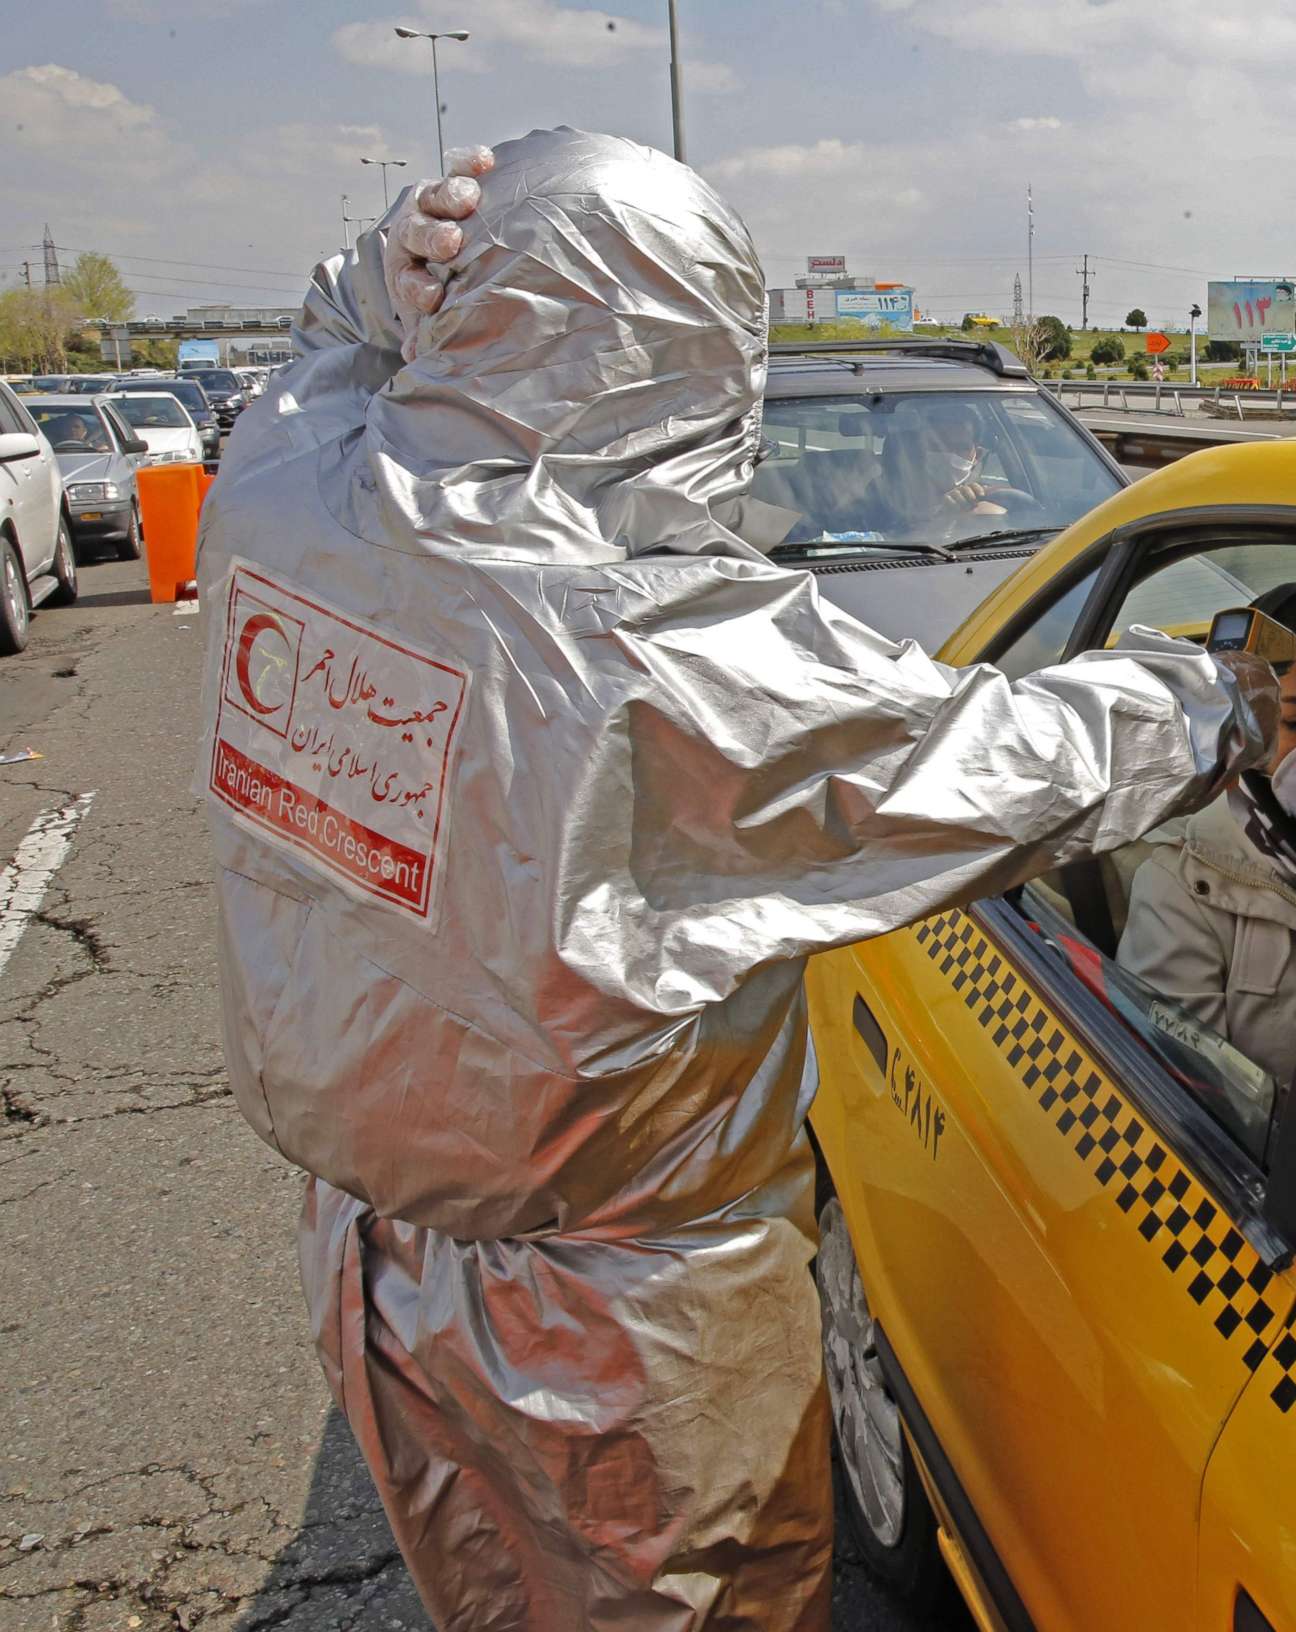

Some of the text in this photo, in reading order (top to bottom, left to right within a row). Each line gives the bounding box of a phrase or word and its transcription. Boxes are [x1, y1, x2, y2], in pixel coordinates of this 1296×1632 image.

[1233, 296, 1271, 329] ۱۱۳
[300, 648, 448, 748] جمعیت هلال احمر
[218, 750, 420, 892] Iranian Red Crescent
[291, 727, 433, 819] جمهوری اسلامی ایران
